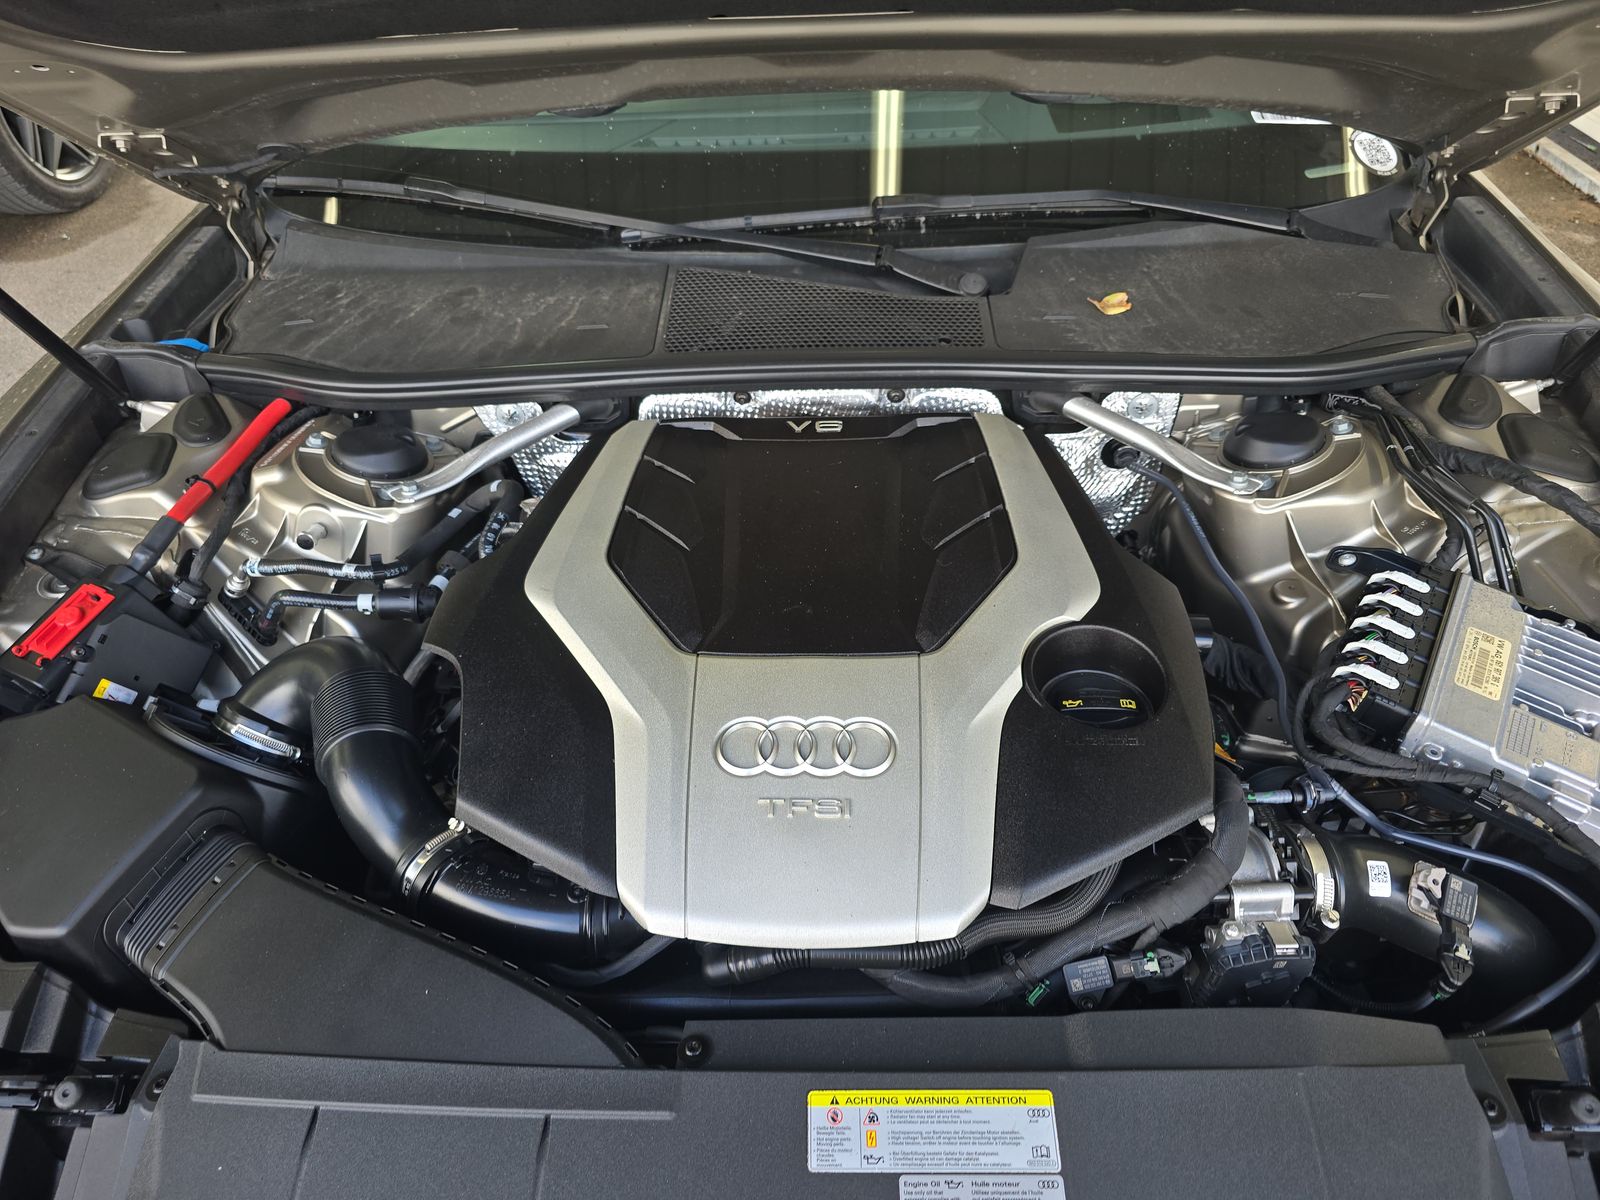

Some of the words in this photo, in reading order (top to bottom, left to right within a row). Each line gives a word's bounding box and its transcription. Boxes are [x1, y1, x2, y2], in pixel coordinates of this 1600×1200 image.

[786, 420, 843, 434] V6
[1495, 650, 1503, 659] AG
[756, 798, 853, 820] TFSI
[845, 1096, 898, 1105] ACHTUNG
[904, 1096, 960, 1104] WARNING
[965, 1096, 1027, 1104] ATTENTION
